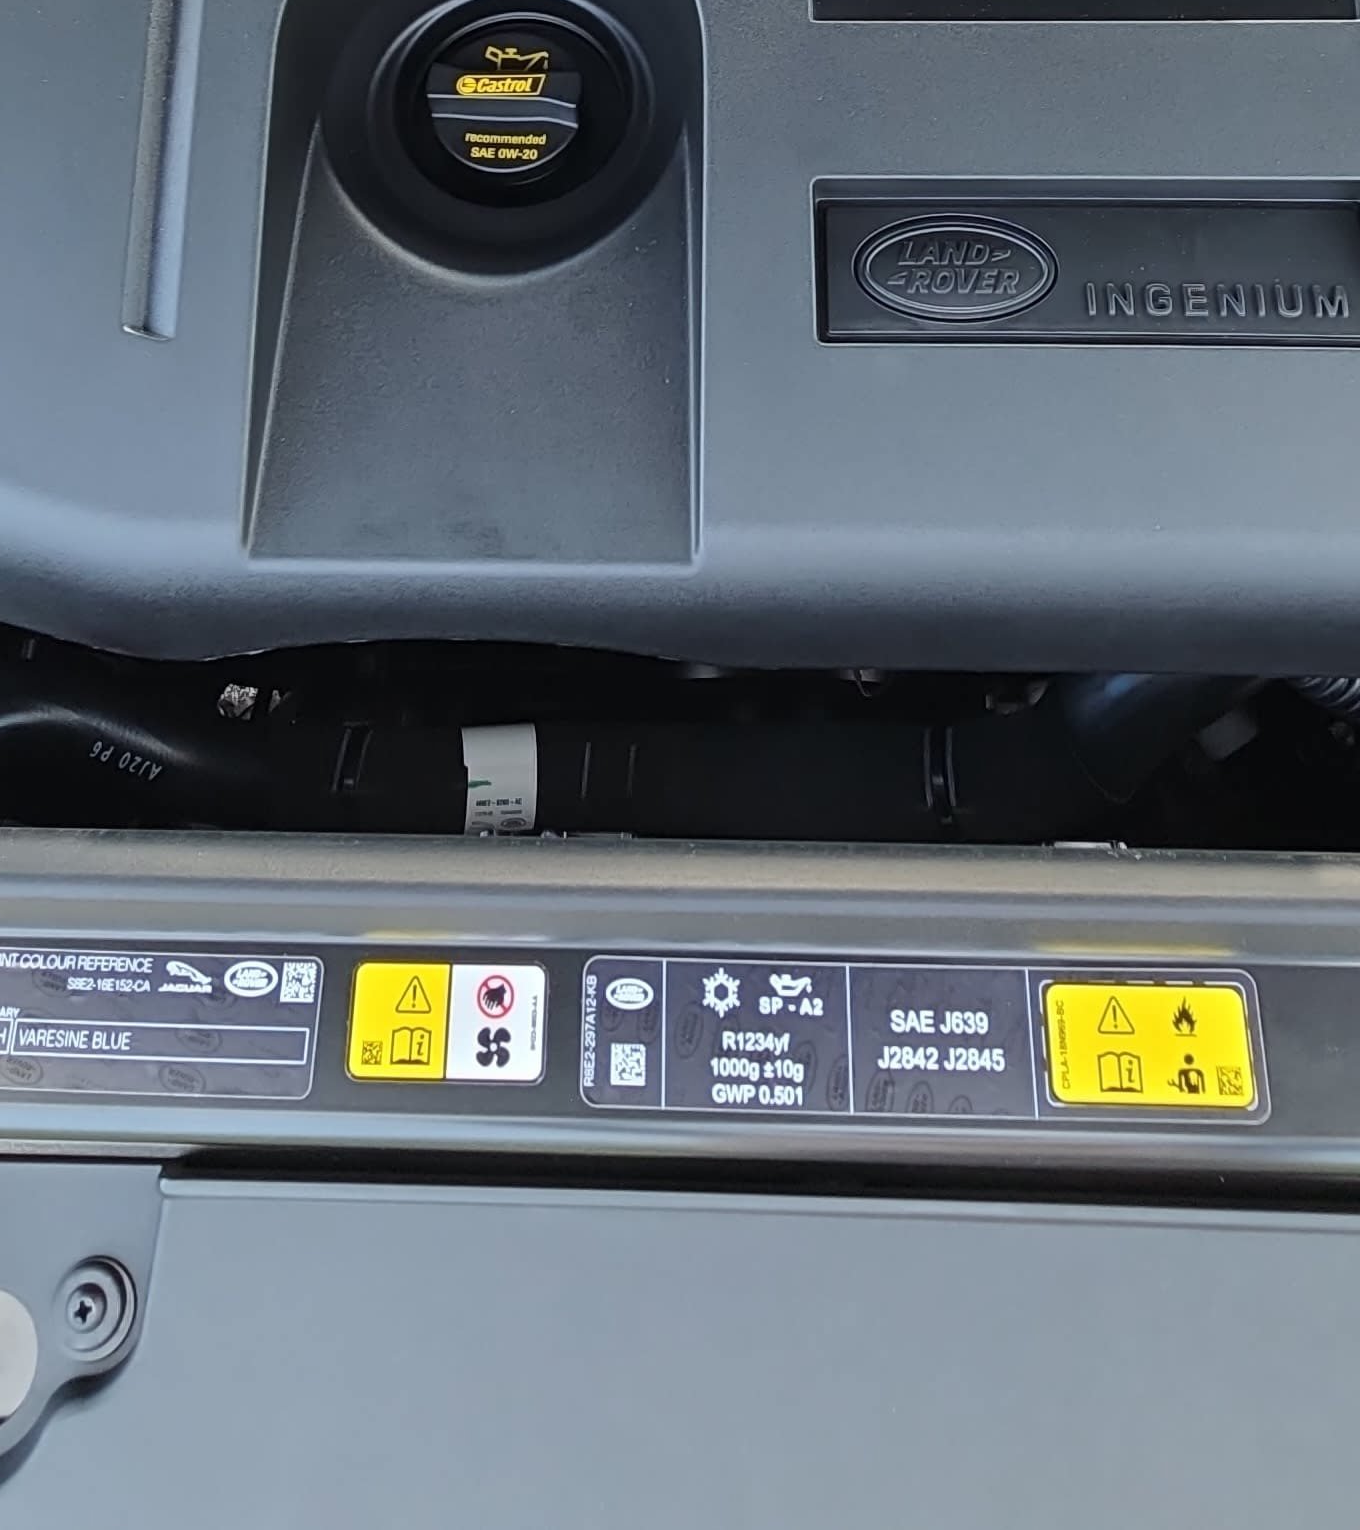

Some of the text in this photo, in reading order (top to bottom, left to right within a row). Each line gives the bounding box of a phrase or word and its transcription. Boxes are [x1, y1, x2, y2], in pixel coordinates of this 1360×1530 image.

[477, 77, 533, 94] Castrol
[465, 132, 547, 147] recommended
[470, 147, 538, 161] SAE 0W-20
[897, 240, 990, 265] LAND
[908, 268, 1020, 295] ROVER
[1085, 281, 1351, 319] INGENIUM
[89, 741, 163, 781] AJ20 P6
[20, 954, 76, 971] COLOUR
[77, 956, 153, 973] REFERENCE
[158, 983, 212, 994] JAGUAR
[759, 998, 783, 1015] SP
[800, 999, 824, 1017] A2
[890, 1010, 989, 1035] SAE J639
[19, 1029, 88, 1050] VARESINE
[91, 1031, 132, 1051] BLUE
[722, 1031, 790, 1053] R1234yf
[711, 1058, 759, 1081] 1000g
[878, 1046, 1005, 1072] J2842 J2845
[712, 1084, 804, 1107] GWP 0.501
